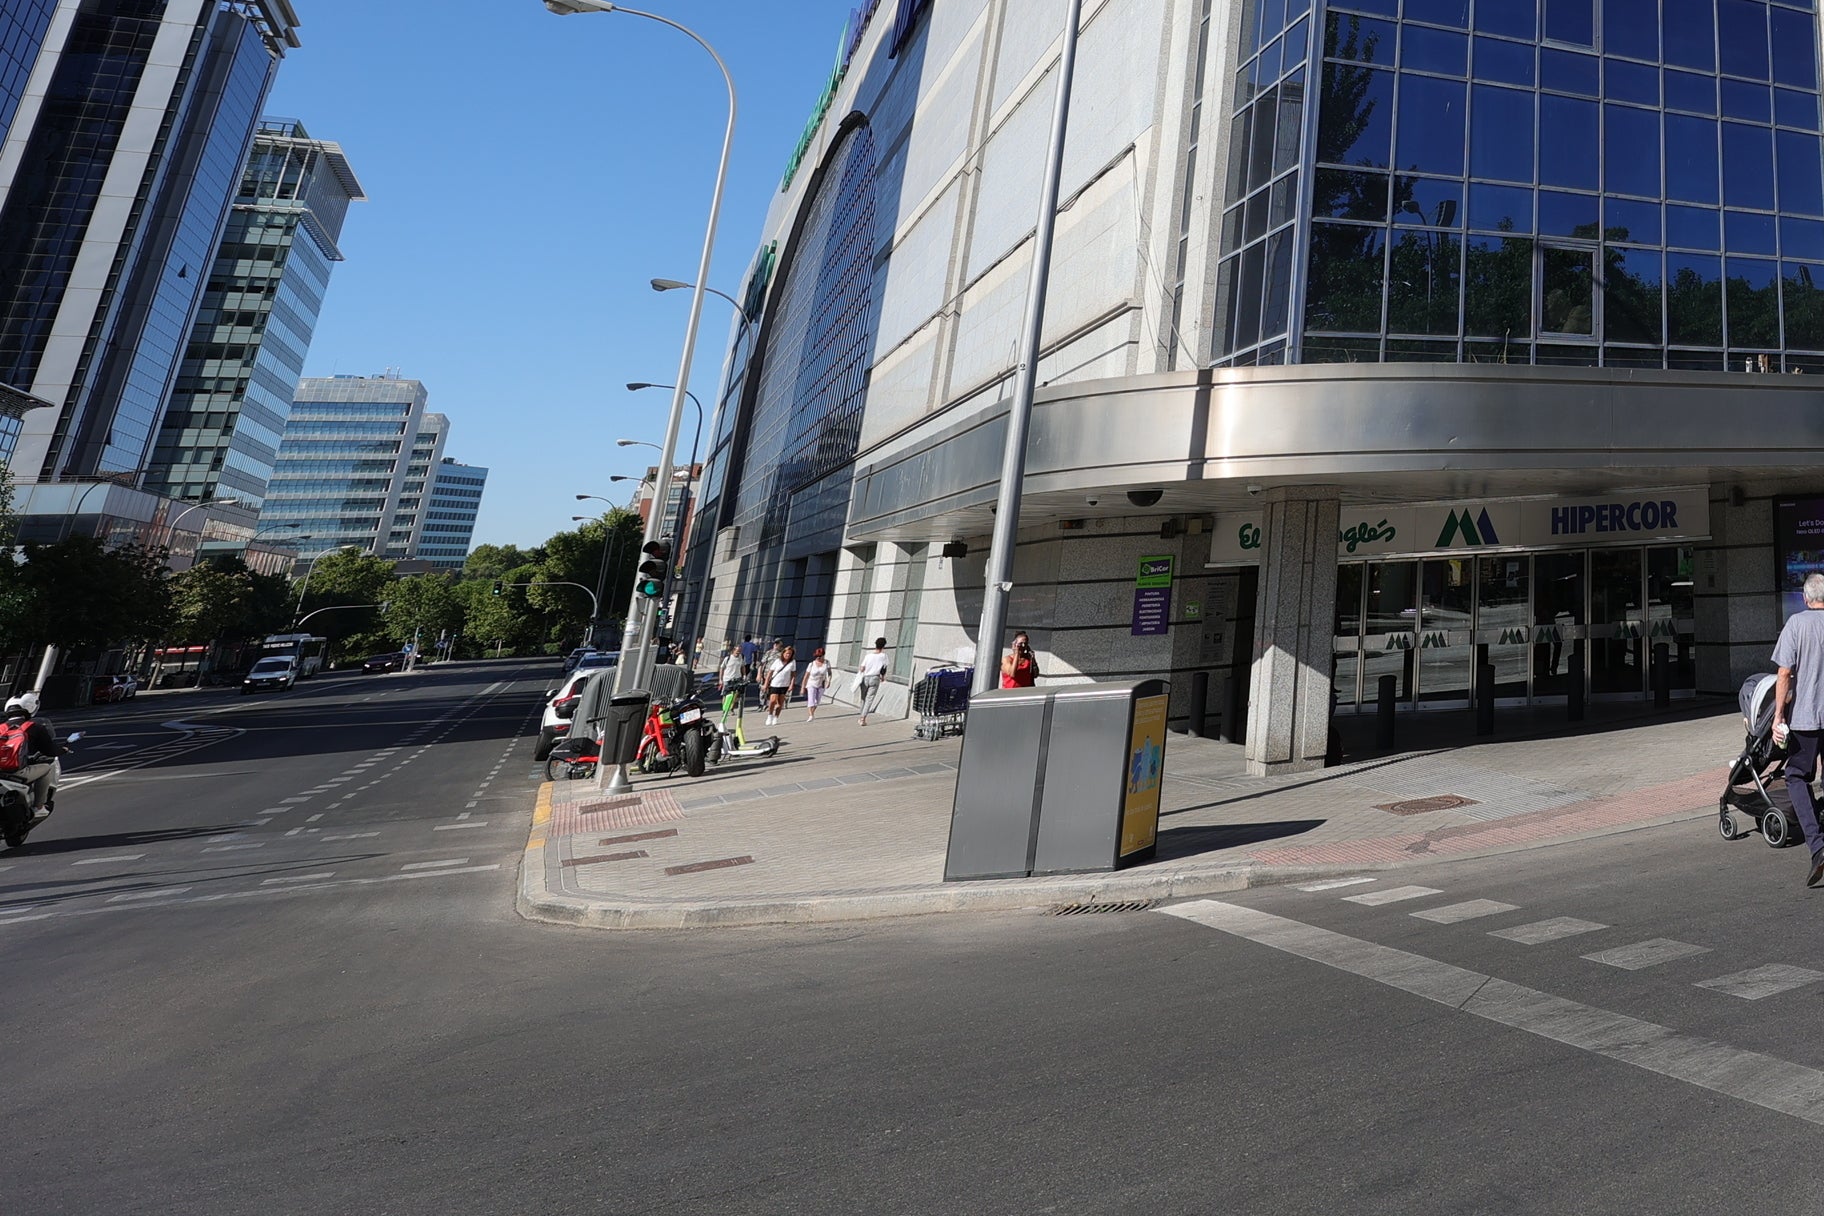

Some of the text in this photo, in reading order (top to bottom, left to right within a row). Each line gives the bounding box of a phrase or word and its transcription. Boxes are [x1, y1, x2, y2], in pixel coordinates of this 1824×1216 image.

[1551, 500, 1679, 535] HIPERCOR
[1238, 519, 1396, 553] El glés
[1151, 565, 1169, 573] BriCor
